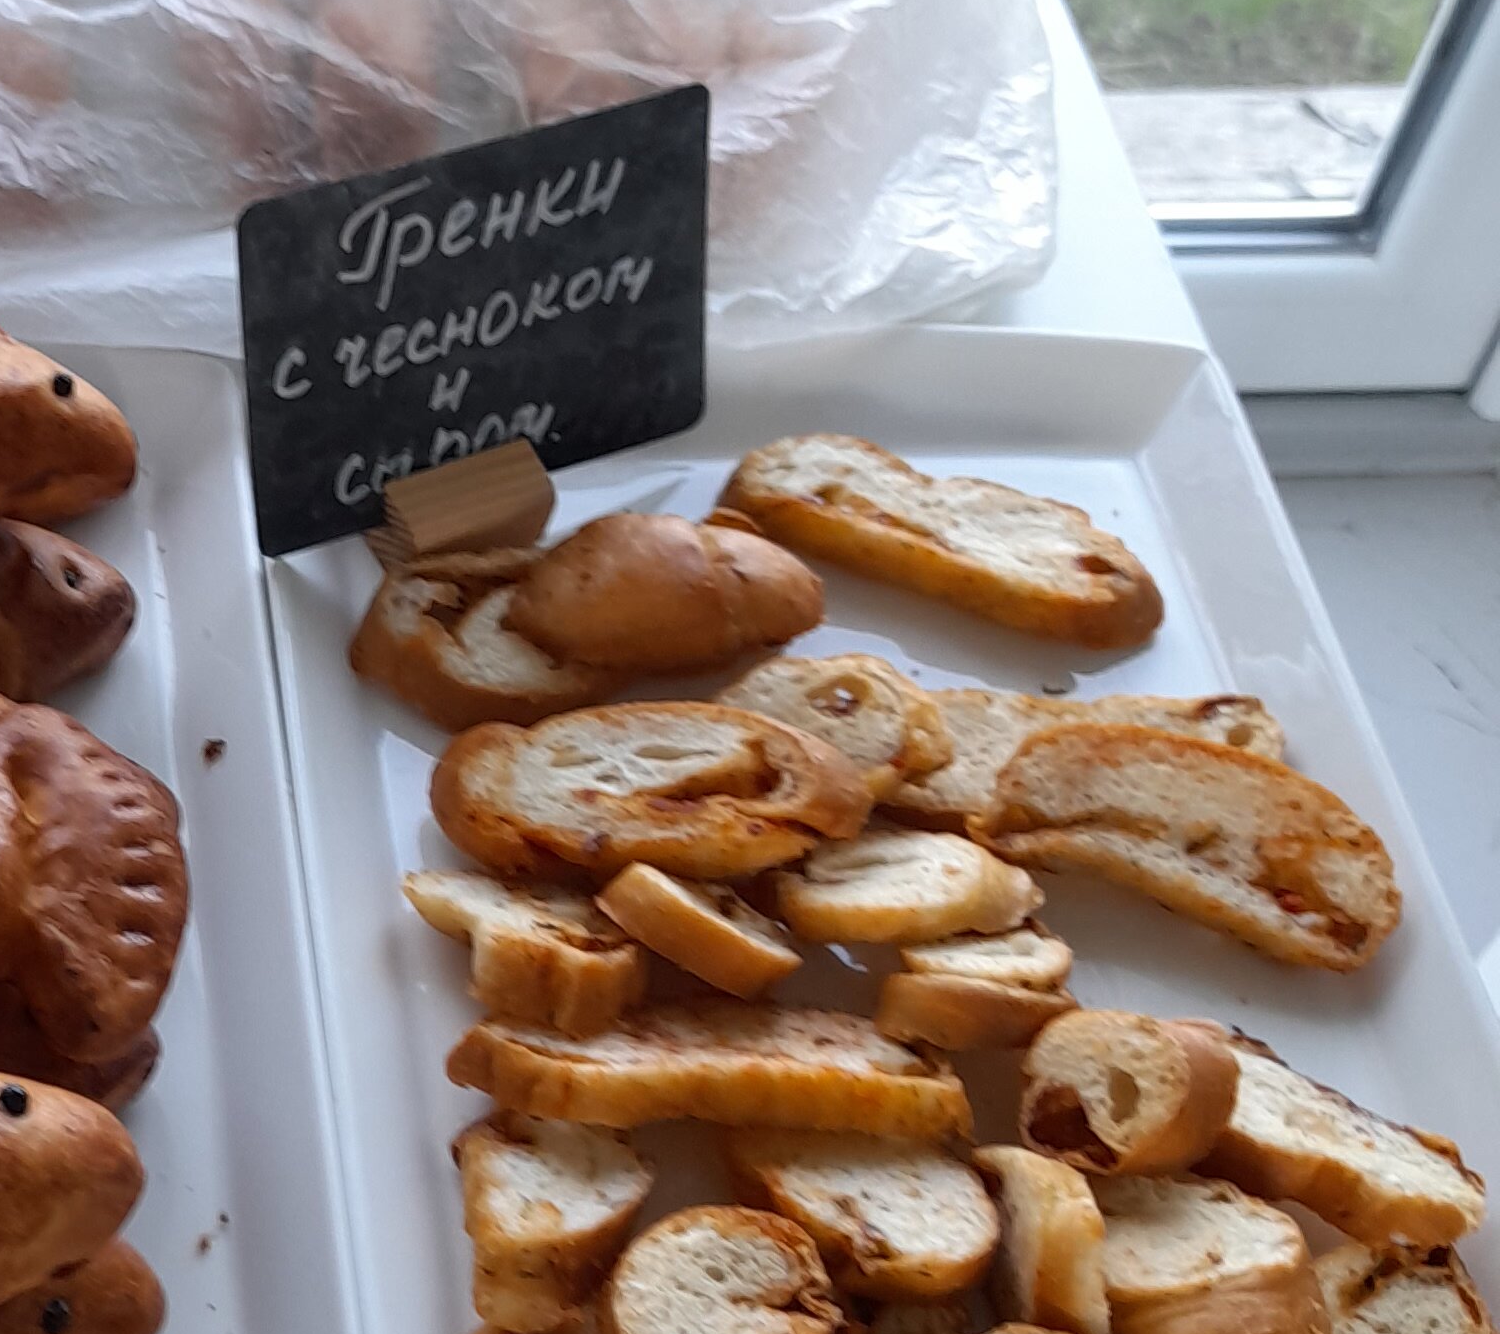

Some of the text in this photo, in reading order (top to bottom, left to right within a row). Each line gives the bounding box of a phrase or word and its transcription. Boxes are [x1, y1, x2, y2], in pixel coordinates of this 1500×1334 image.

[337, 158, 625, 312] Гренки
[333, 256, 653, 388] чесноком
[427, 367, 470, 413] и
